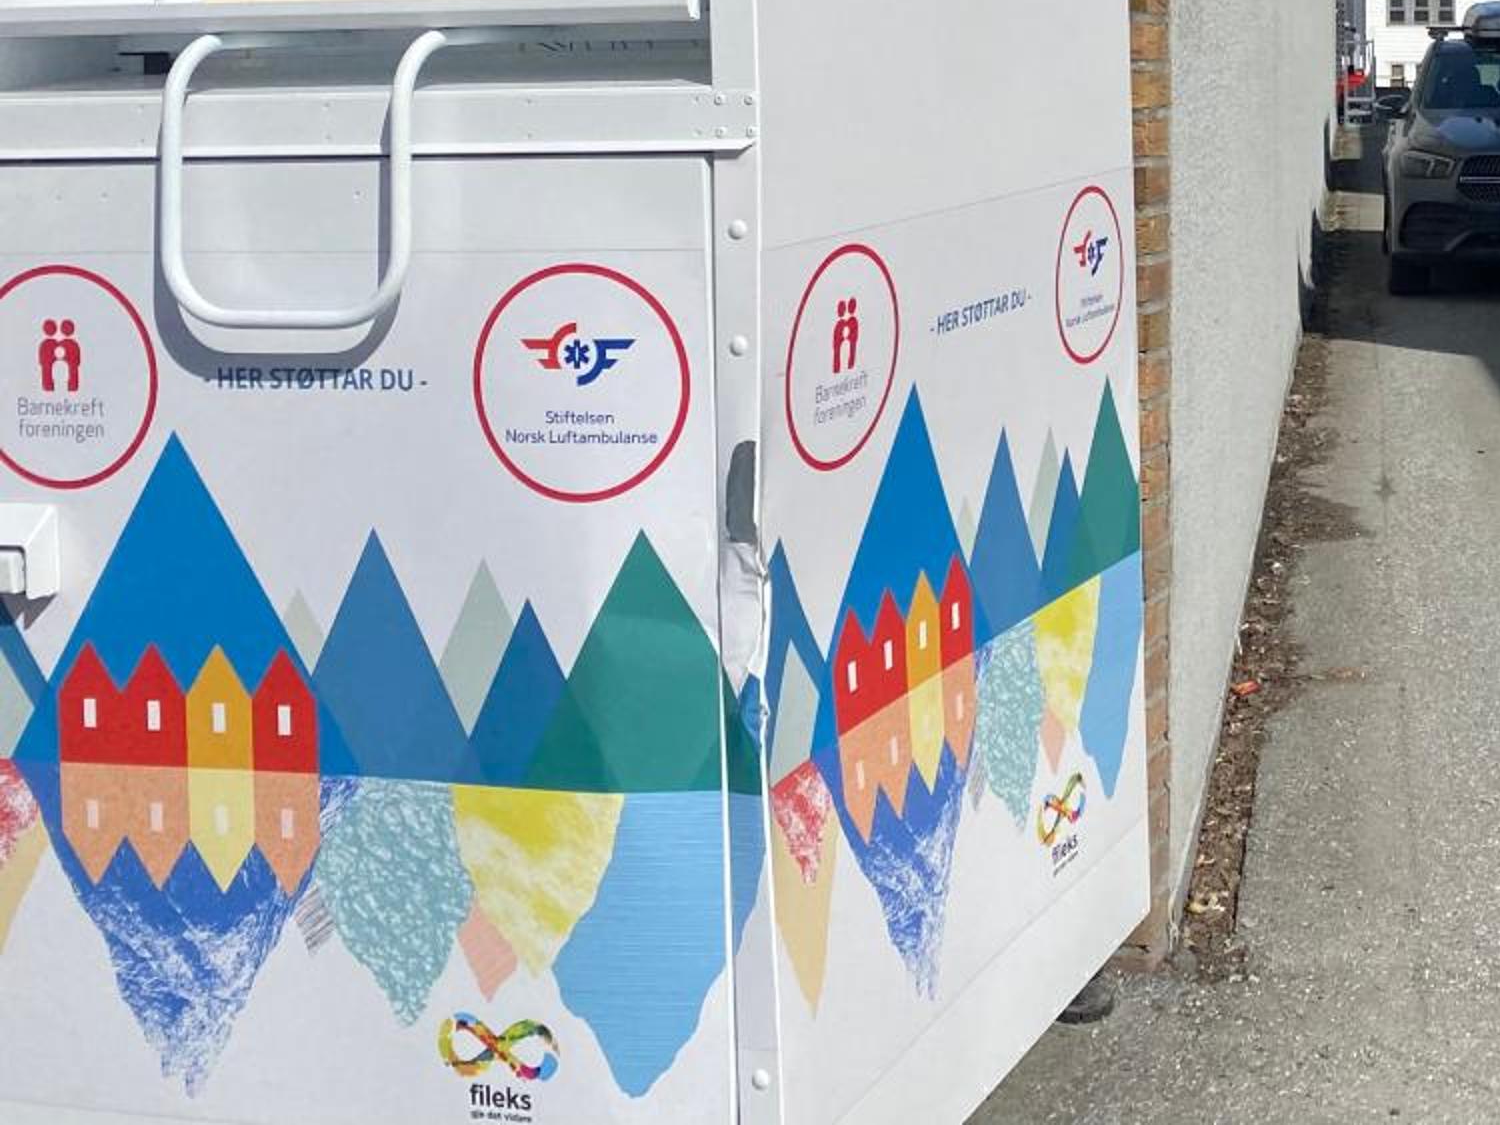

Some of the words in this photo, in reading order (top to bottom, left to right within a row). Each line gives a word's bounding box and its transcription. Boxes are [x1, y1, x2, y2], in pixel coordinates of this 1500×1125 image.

[937, 310, 959, 335] HER
[961, 295, 1009, 327] STØTTAR
[1011, 287, 1026, 309] DU
[217, 366, 263, 389] HER
[269, 366, 373, 390] STØTTAR
[381, 368, 413, 391] DU
[17, 397, 104, 417] Barnekreft
[545, 410, 615, 425] Stiftelsen
[18, 419, 105, 443] foreningen
[505, 430, 546, 445] Norsk
[549, 430, 658, 445] Luftambulanse
[470, 1083, 532, 1111] fileks
